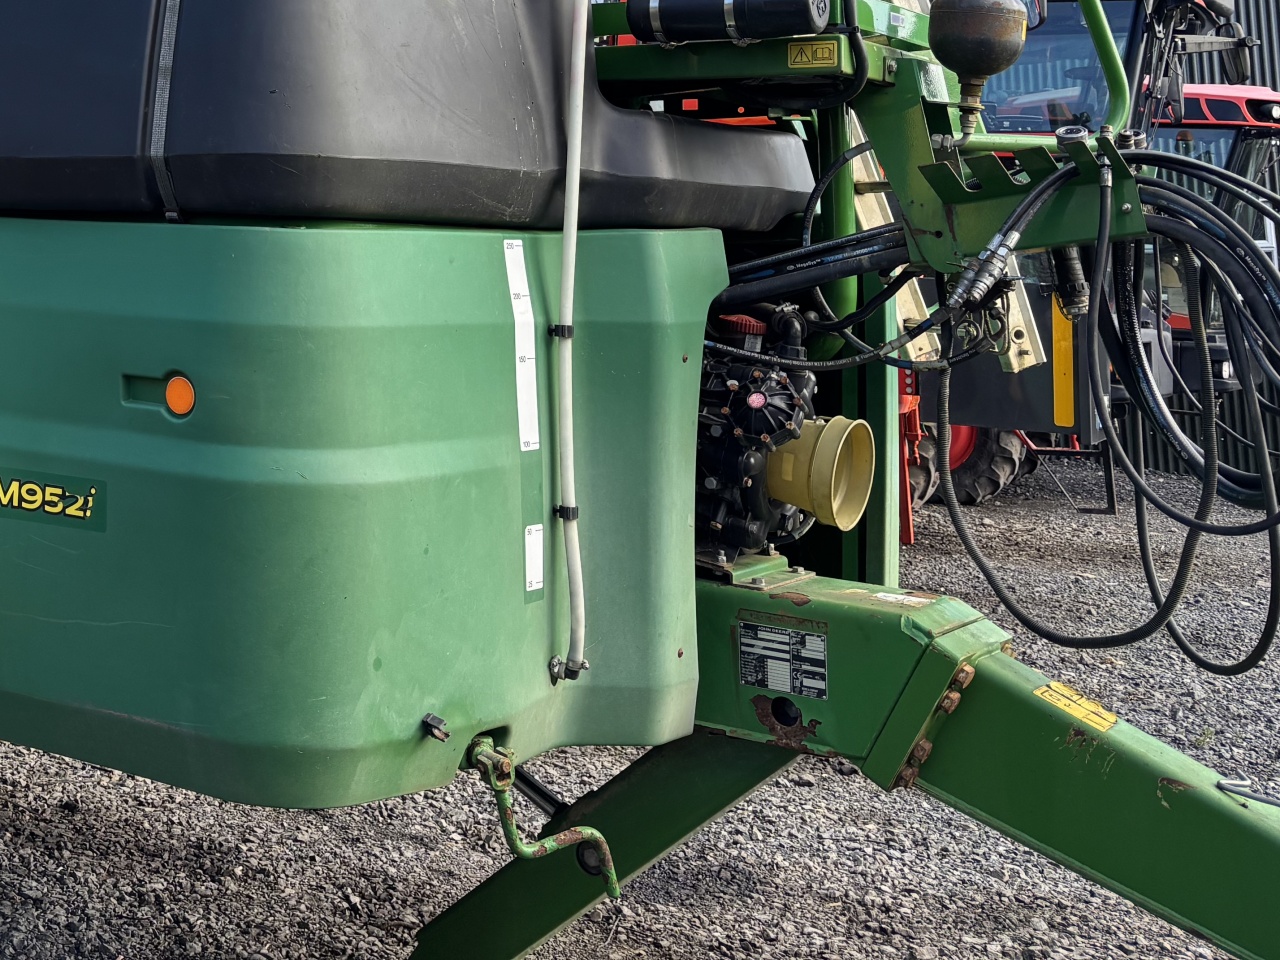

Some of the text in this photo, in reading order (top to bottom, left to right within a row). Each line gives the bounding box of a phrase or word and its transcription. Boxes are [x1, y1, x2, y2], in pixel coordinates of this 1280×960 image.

[506, 242, 515, 250] 250
[512, 292, 522, 300] 200
[518, 355, 527, 363] 150
[522, 440, 531, 448] 100
